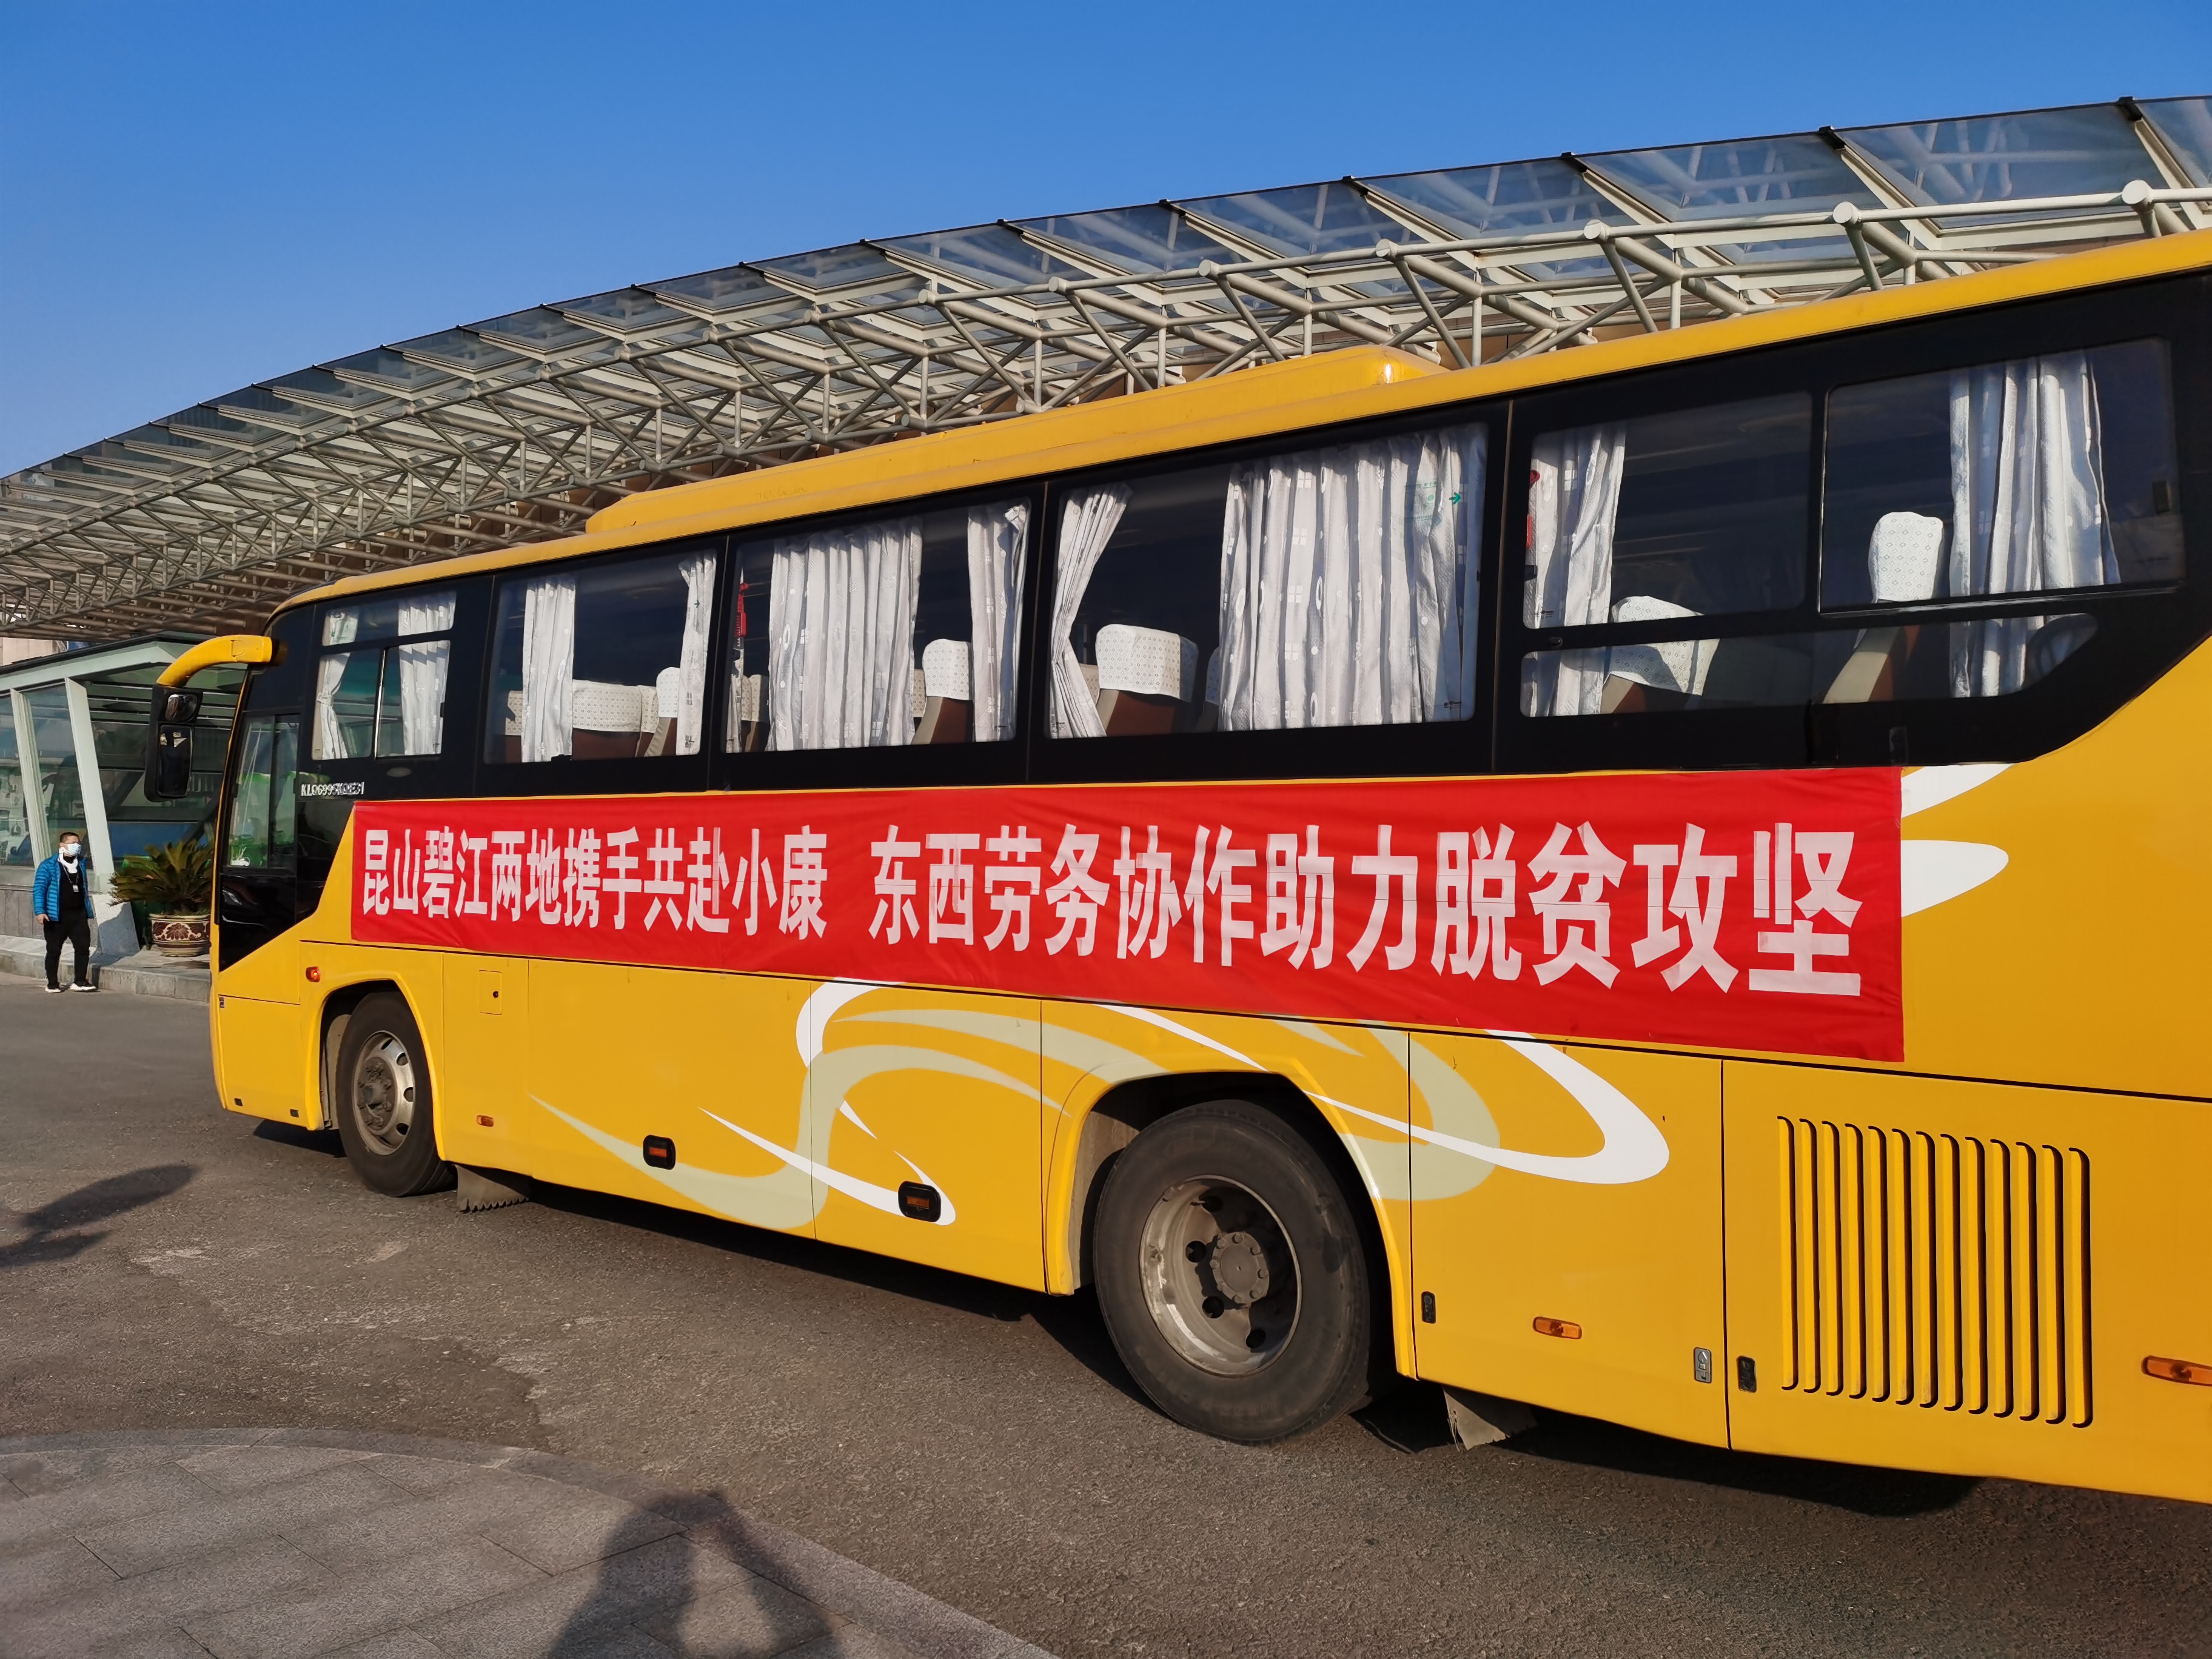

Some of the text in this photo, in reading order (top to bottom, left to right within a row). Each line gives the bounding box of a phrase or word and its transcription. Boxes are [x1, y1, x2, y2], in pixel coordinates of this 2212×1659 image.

[363, 822, 1863, 997] 昆山碧江两地携手共赴小康 东西劳务协作助力脱贫攻坚
